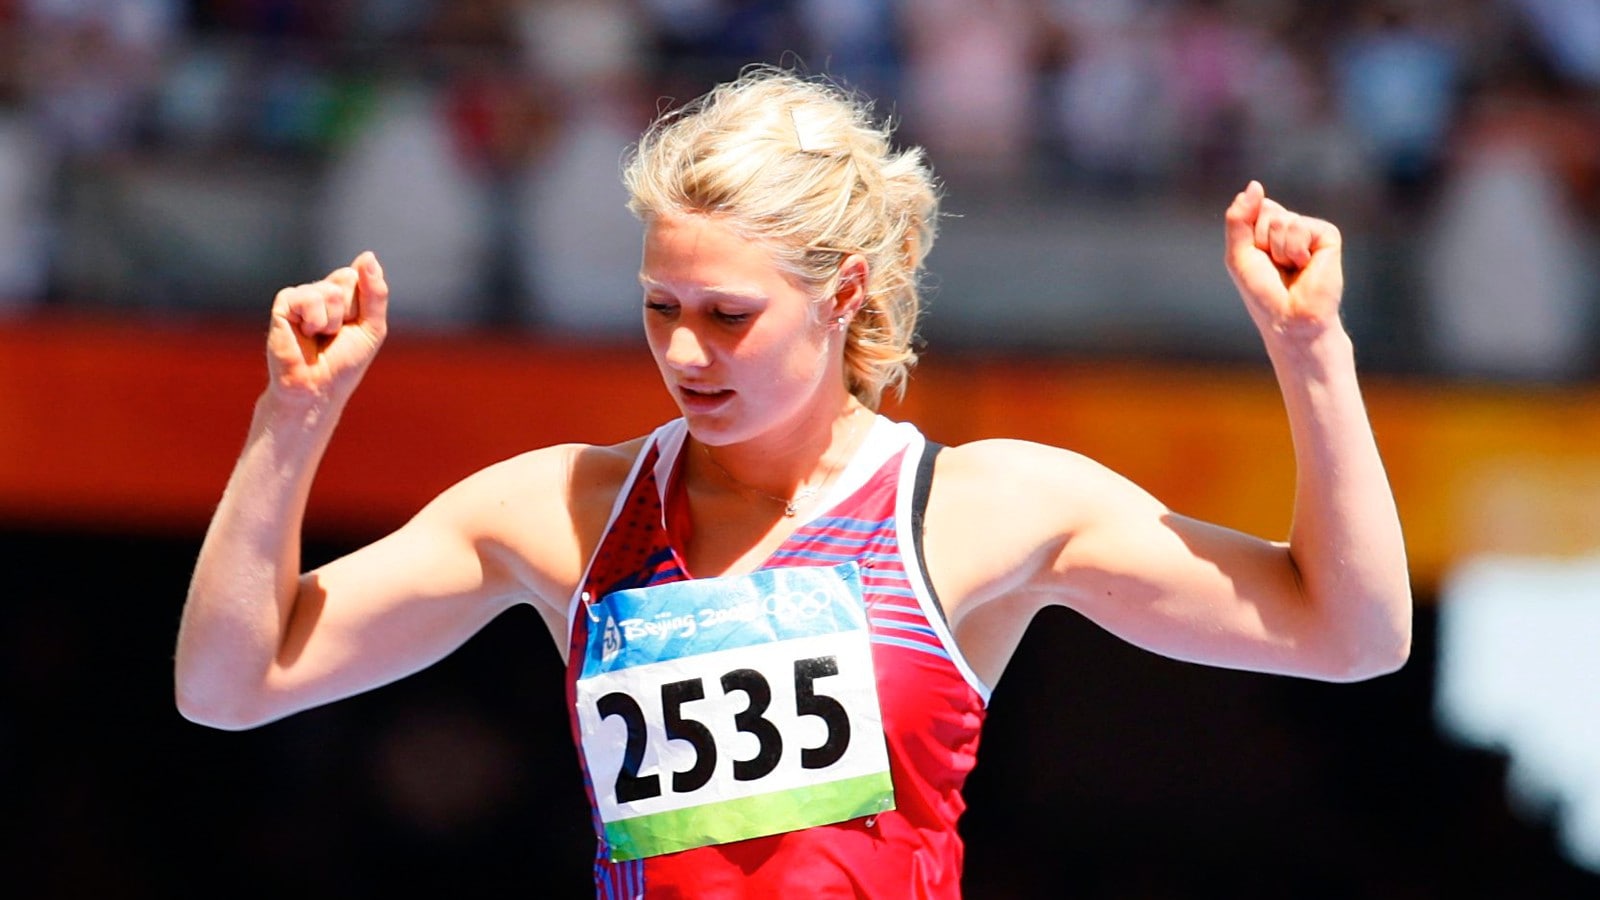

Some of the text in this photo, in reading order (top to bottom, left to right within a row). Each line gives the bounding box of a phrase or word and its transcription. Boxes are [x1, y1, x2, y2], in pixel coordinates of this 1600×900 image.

[619, 601, 758, 641] Beijing 200
[596, 655, 851, 804] 2535
